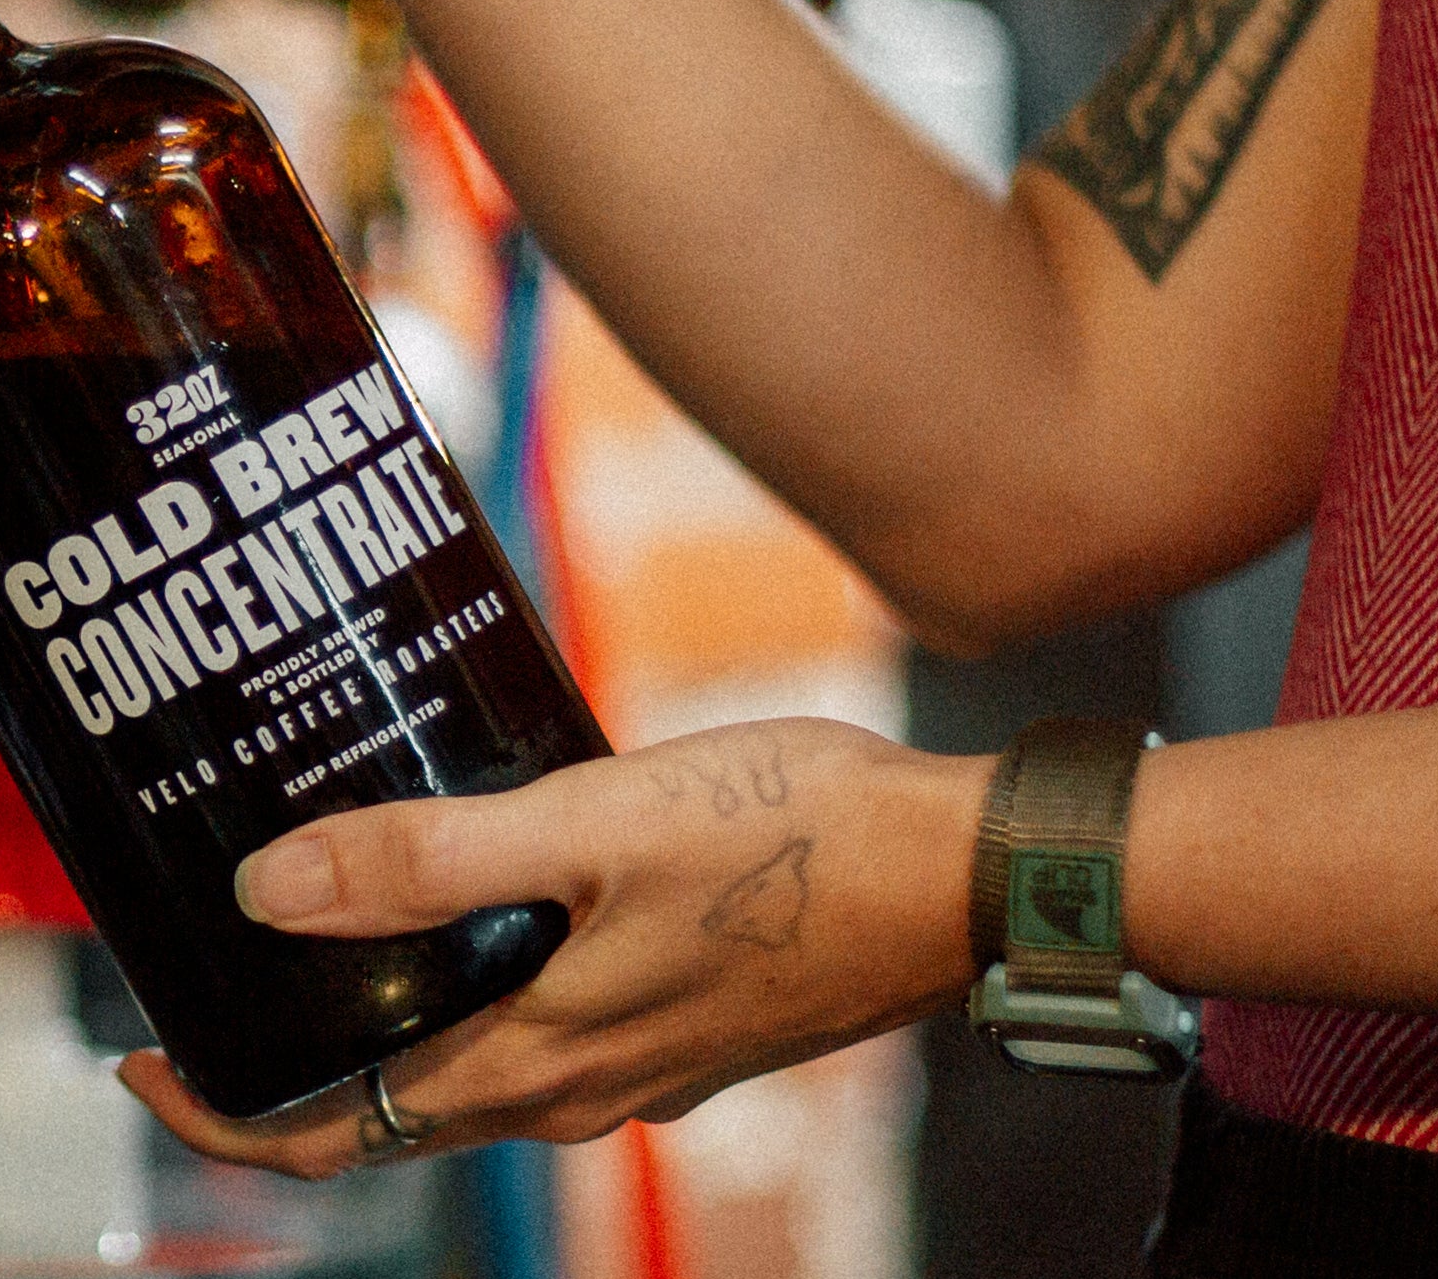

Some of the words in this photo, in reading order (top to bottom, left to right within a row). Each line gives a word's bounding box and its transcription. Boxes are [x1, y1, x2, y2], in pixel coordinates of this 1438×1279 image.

[153, 411, 242, 468] SEASONAL
[4, 481, 212, 629] COLD
[210, 362, 405, 518] BREW
[47, 437, 466, 735] CONCENTRATE
[138, 758, 217, 814] VELO
[234, 679, 362, 763] COFFEE
[375, 590, 504, 686] ROASTERS
[240, 644, 319, 697] PROUDLY
[269, 689, 284, 705] &
[286, 648, 356, 695] BOTTLED
[357, 632, 379, 655] BY
[283, 764, 327, 798] KEEP
[329, 697, 446, 773] REFRIGERATED
